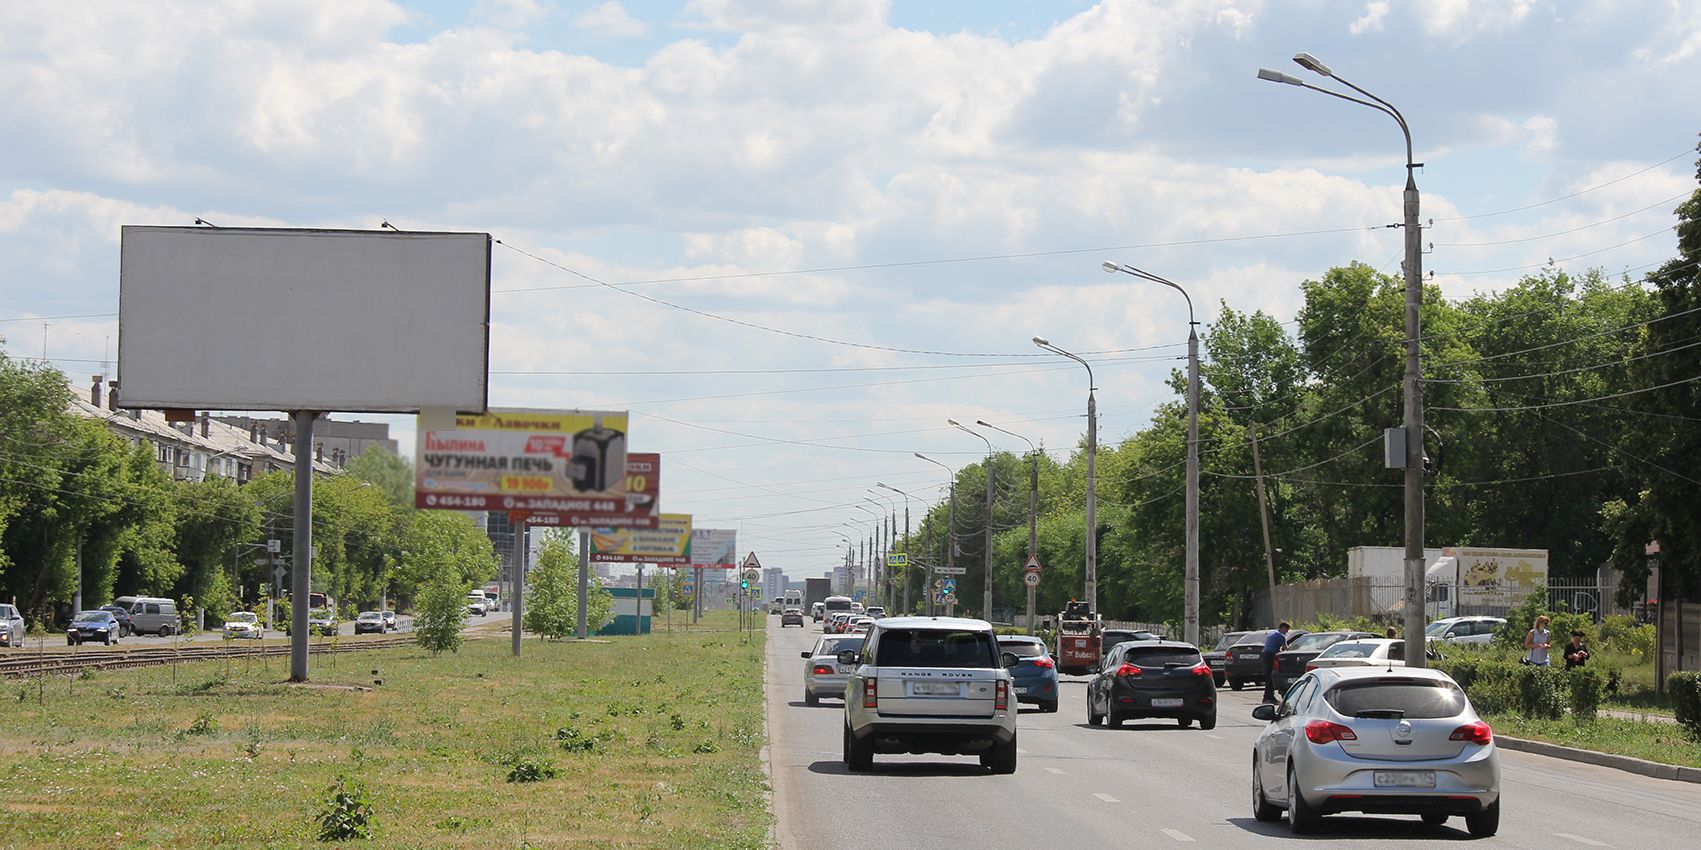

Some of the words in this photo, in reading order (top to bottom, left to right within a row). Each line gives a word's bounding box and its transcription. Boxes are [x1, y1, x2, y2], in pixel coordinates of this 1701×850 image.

[424, 454, 508, 469] ЧУГУННАЯ
[512, 456, 553, 471] ПЕЧЬ
[439, 496, 486, 507] 454-180
